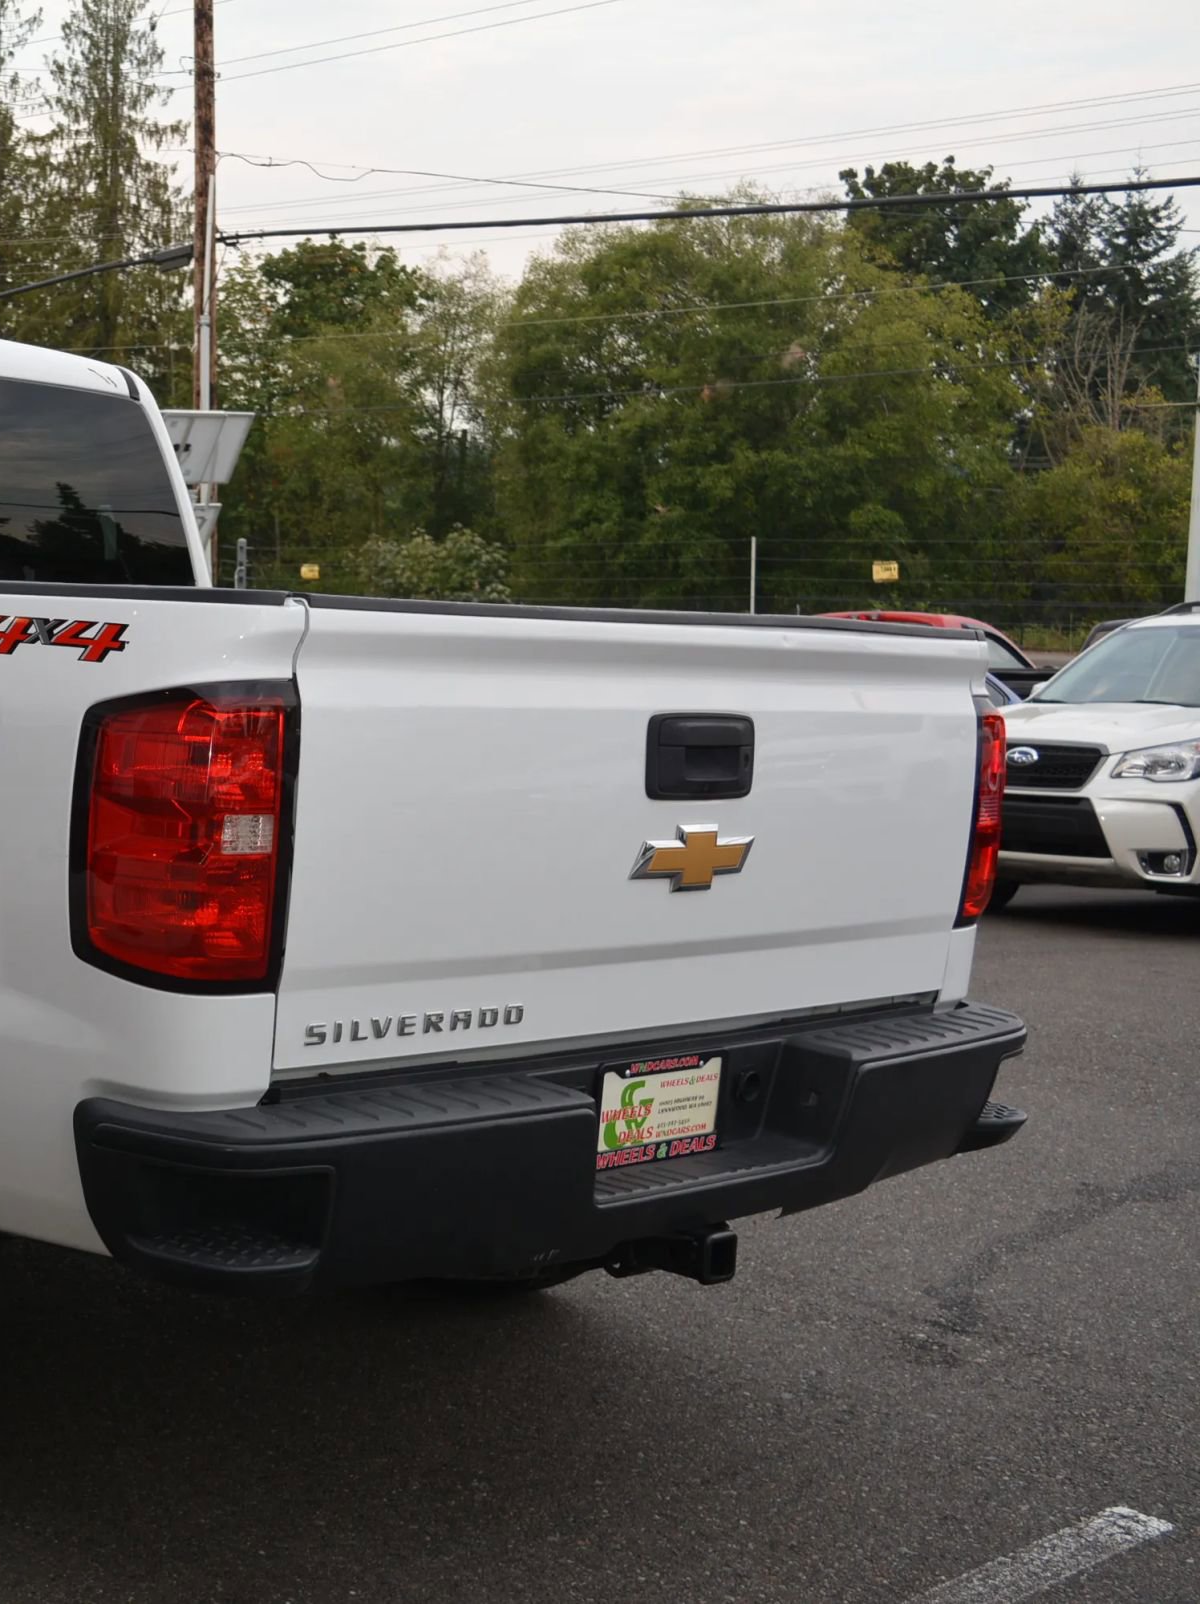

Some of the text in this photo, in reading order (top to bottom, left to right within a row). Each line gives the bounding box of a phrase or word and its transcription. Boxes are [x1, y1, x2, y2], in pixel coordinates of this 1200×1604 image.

[304, 1003, 524, 1046] SILVERADO
[660, 1073, 719, 1088] WHEELS & DEALS
[601, 1103, 653, 1123] WHEELS
[618, 1126, 653, 1144] DEALS
[596, 1135, 716, 1169] WHEELS & DEALS
